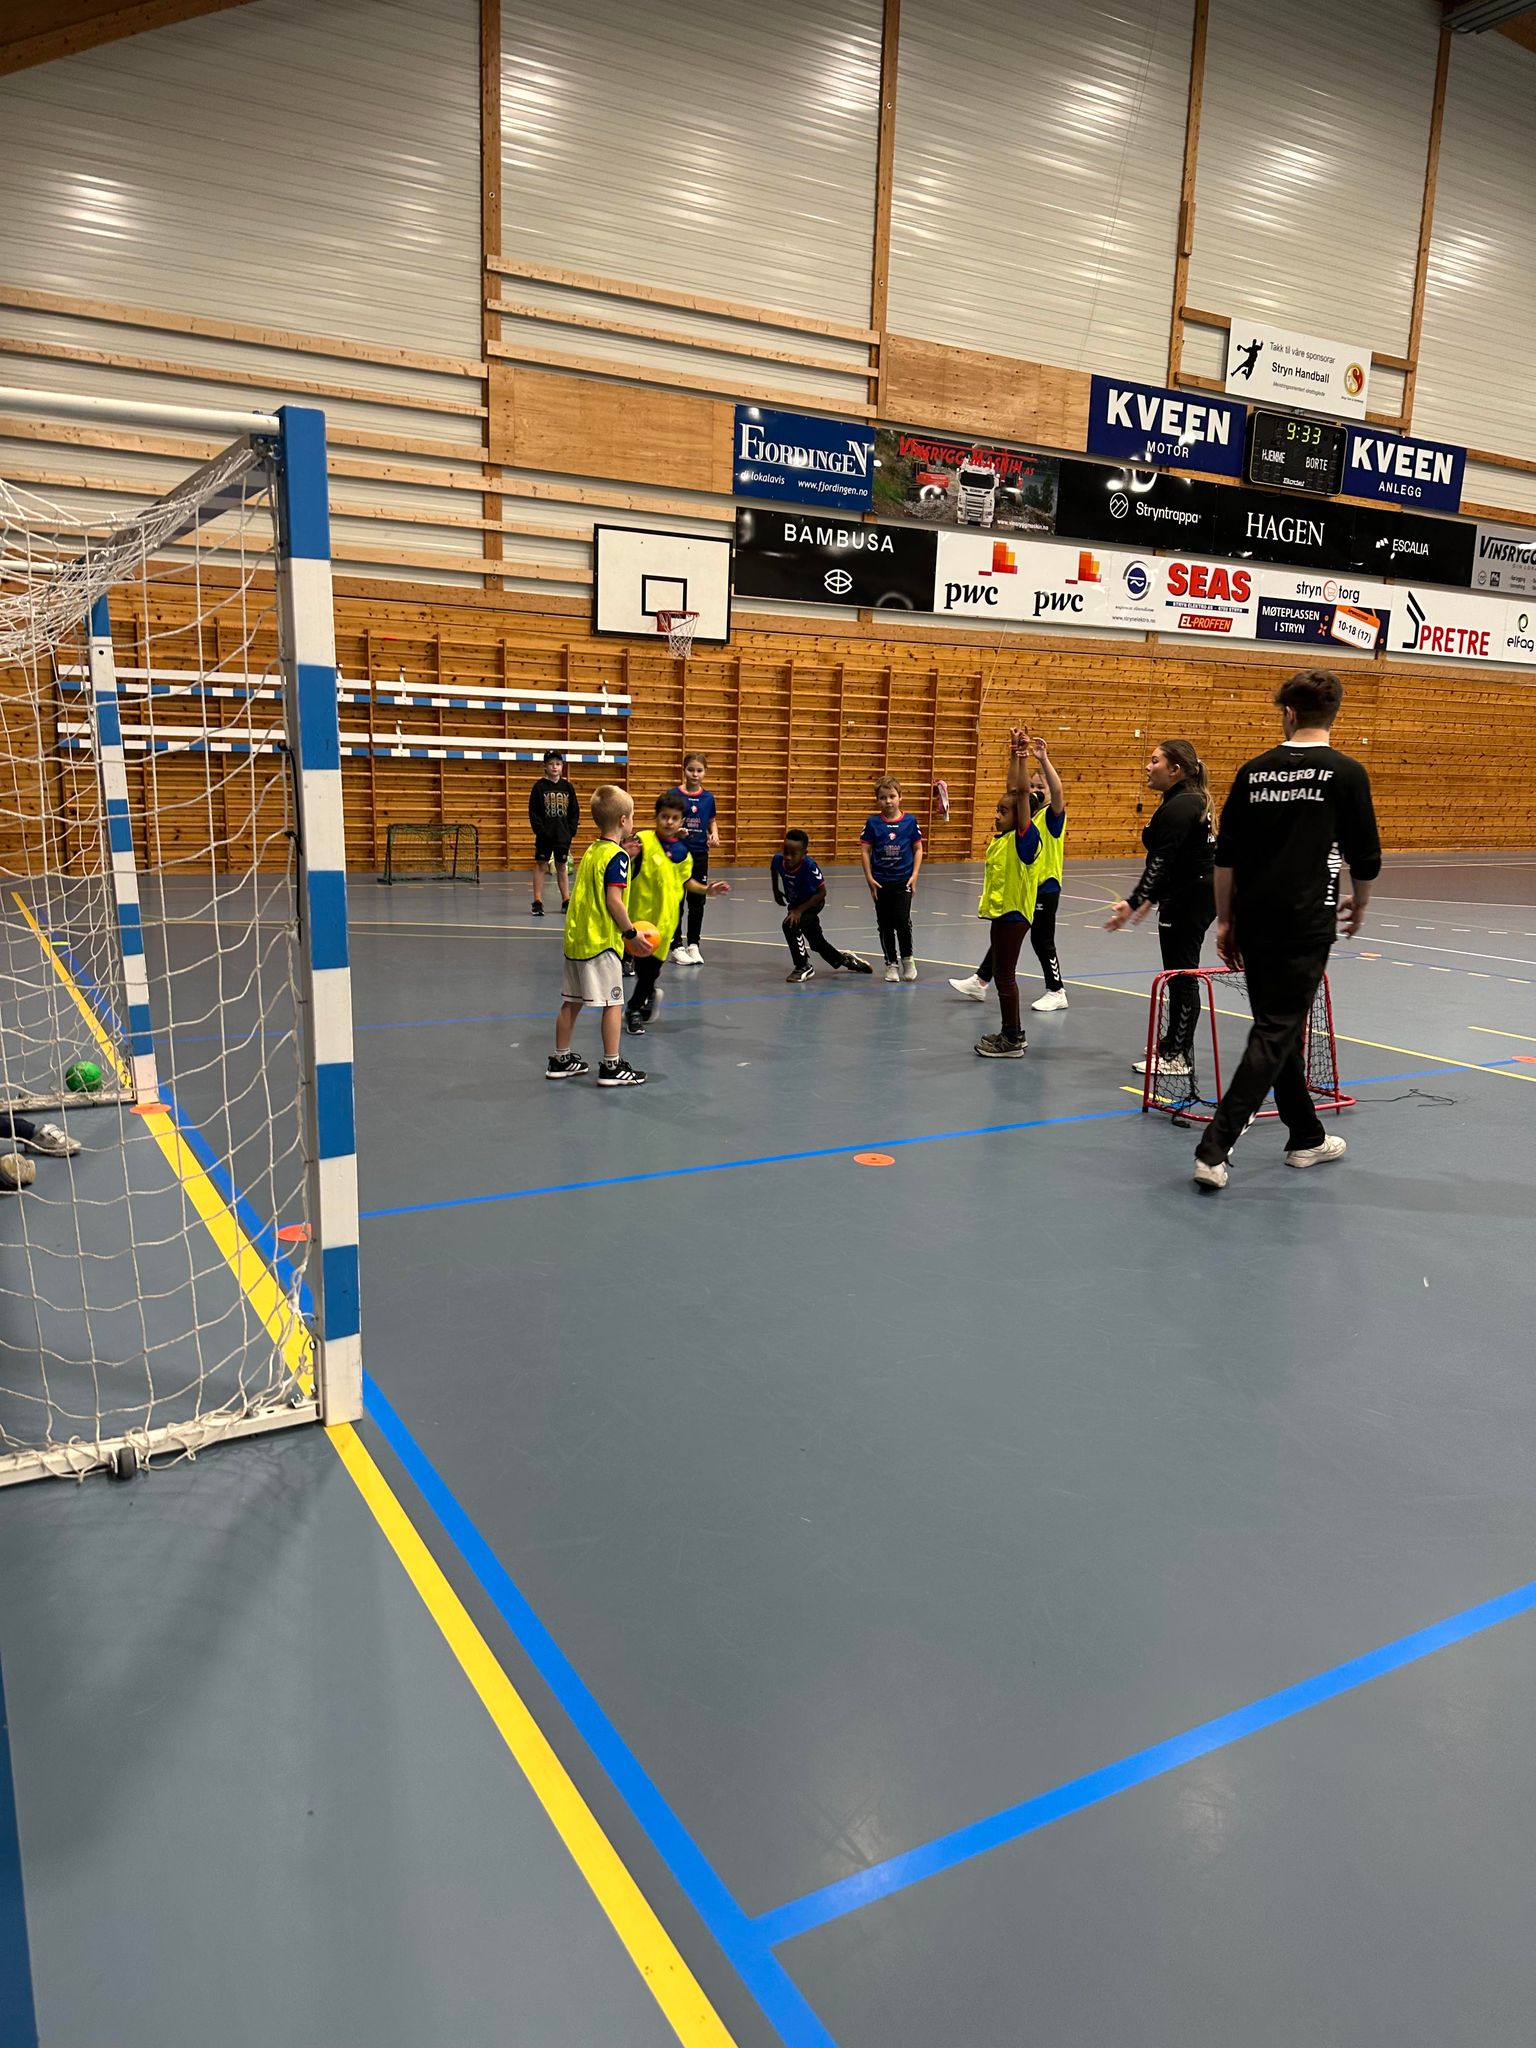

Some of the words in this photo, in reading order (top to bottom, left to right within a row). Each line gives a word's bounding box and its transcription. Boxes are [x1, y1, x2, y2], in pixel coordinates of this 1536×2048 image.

[1270, 341, 1284, 352] Takk
[1292, 347, 1305, 357] våre
[1306, 352, 1336, 363] sponsorar
[1272, 361, 1293, 377] Stryn
[1295, 367, 1330, 383] Handball
[1107, 388, 1231, 446] KVEEN
[1286, 421, 1322, 446] 9:33
[1146, 440, 1190, 459] MOTOR
[1261, 448, 1286, 464] HJEMME
[1305, 456, 1329, 472] BORTE
[1351, 436, 1454, 485] KVEEN
[750, 471, 786, 485] lokalavis
[798, 479, 869, 497] www.fjordingen.no
[1378, 480, 1423, 498] ANLEGG
[1135, 501, 1199, 526] Stryntrappa
[784, 523, 895, 553] BAMBUSA
[1245, 511, 1326, 547] HAGEN
[1392, 538, 1430, 556] ESCALIA
[1167, 562, 1252, 603] SEAS
[1296, 581, 1322, 599] stryn
[1338, 585, 1360, 603] torg
[944, 582, 999, 610] pwc
[1032, 590, 1085, 617] pwc
[1180, 615, 1232, 631] EL-PROFFEN
[1261, 605, 1320, 621] MØTEPLASSEN
[1274, 621, 1278, 632] I
[1279, 622, 1305, 634] STRYN
[1338, 620, 1357, 636] 10-18
[1357, 629, 1371, 644] (17)
[1419, 625, 1491, 657] PRETRE
[1506, 634, 1535, 652] elfag
[1249, 768, 1316, 785] KRAGERØ
[1317, 769, 1335, 782] IF
